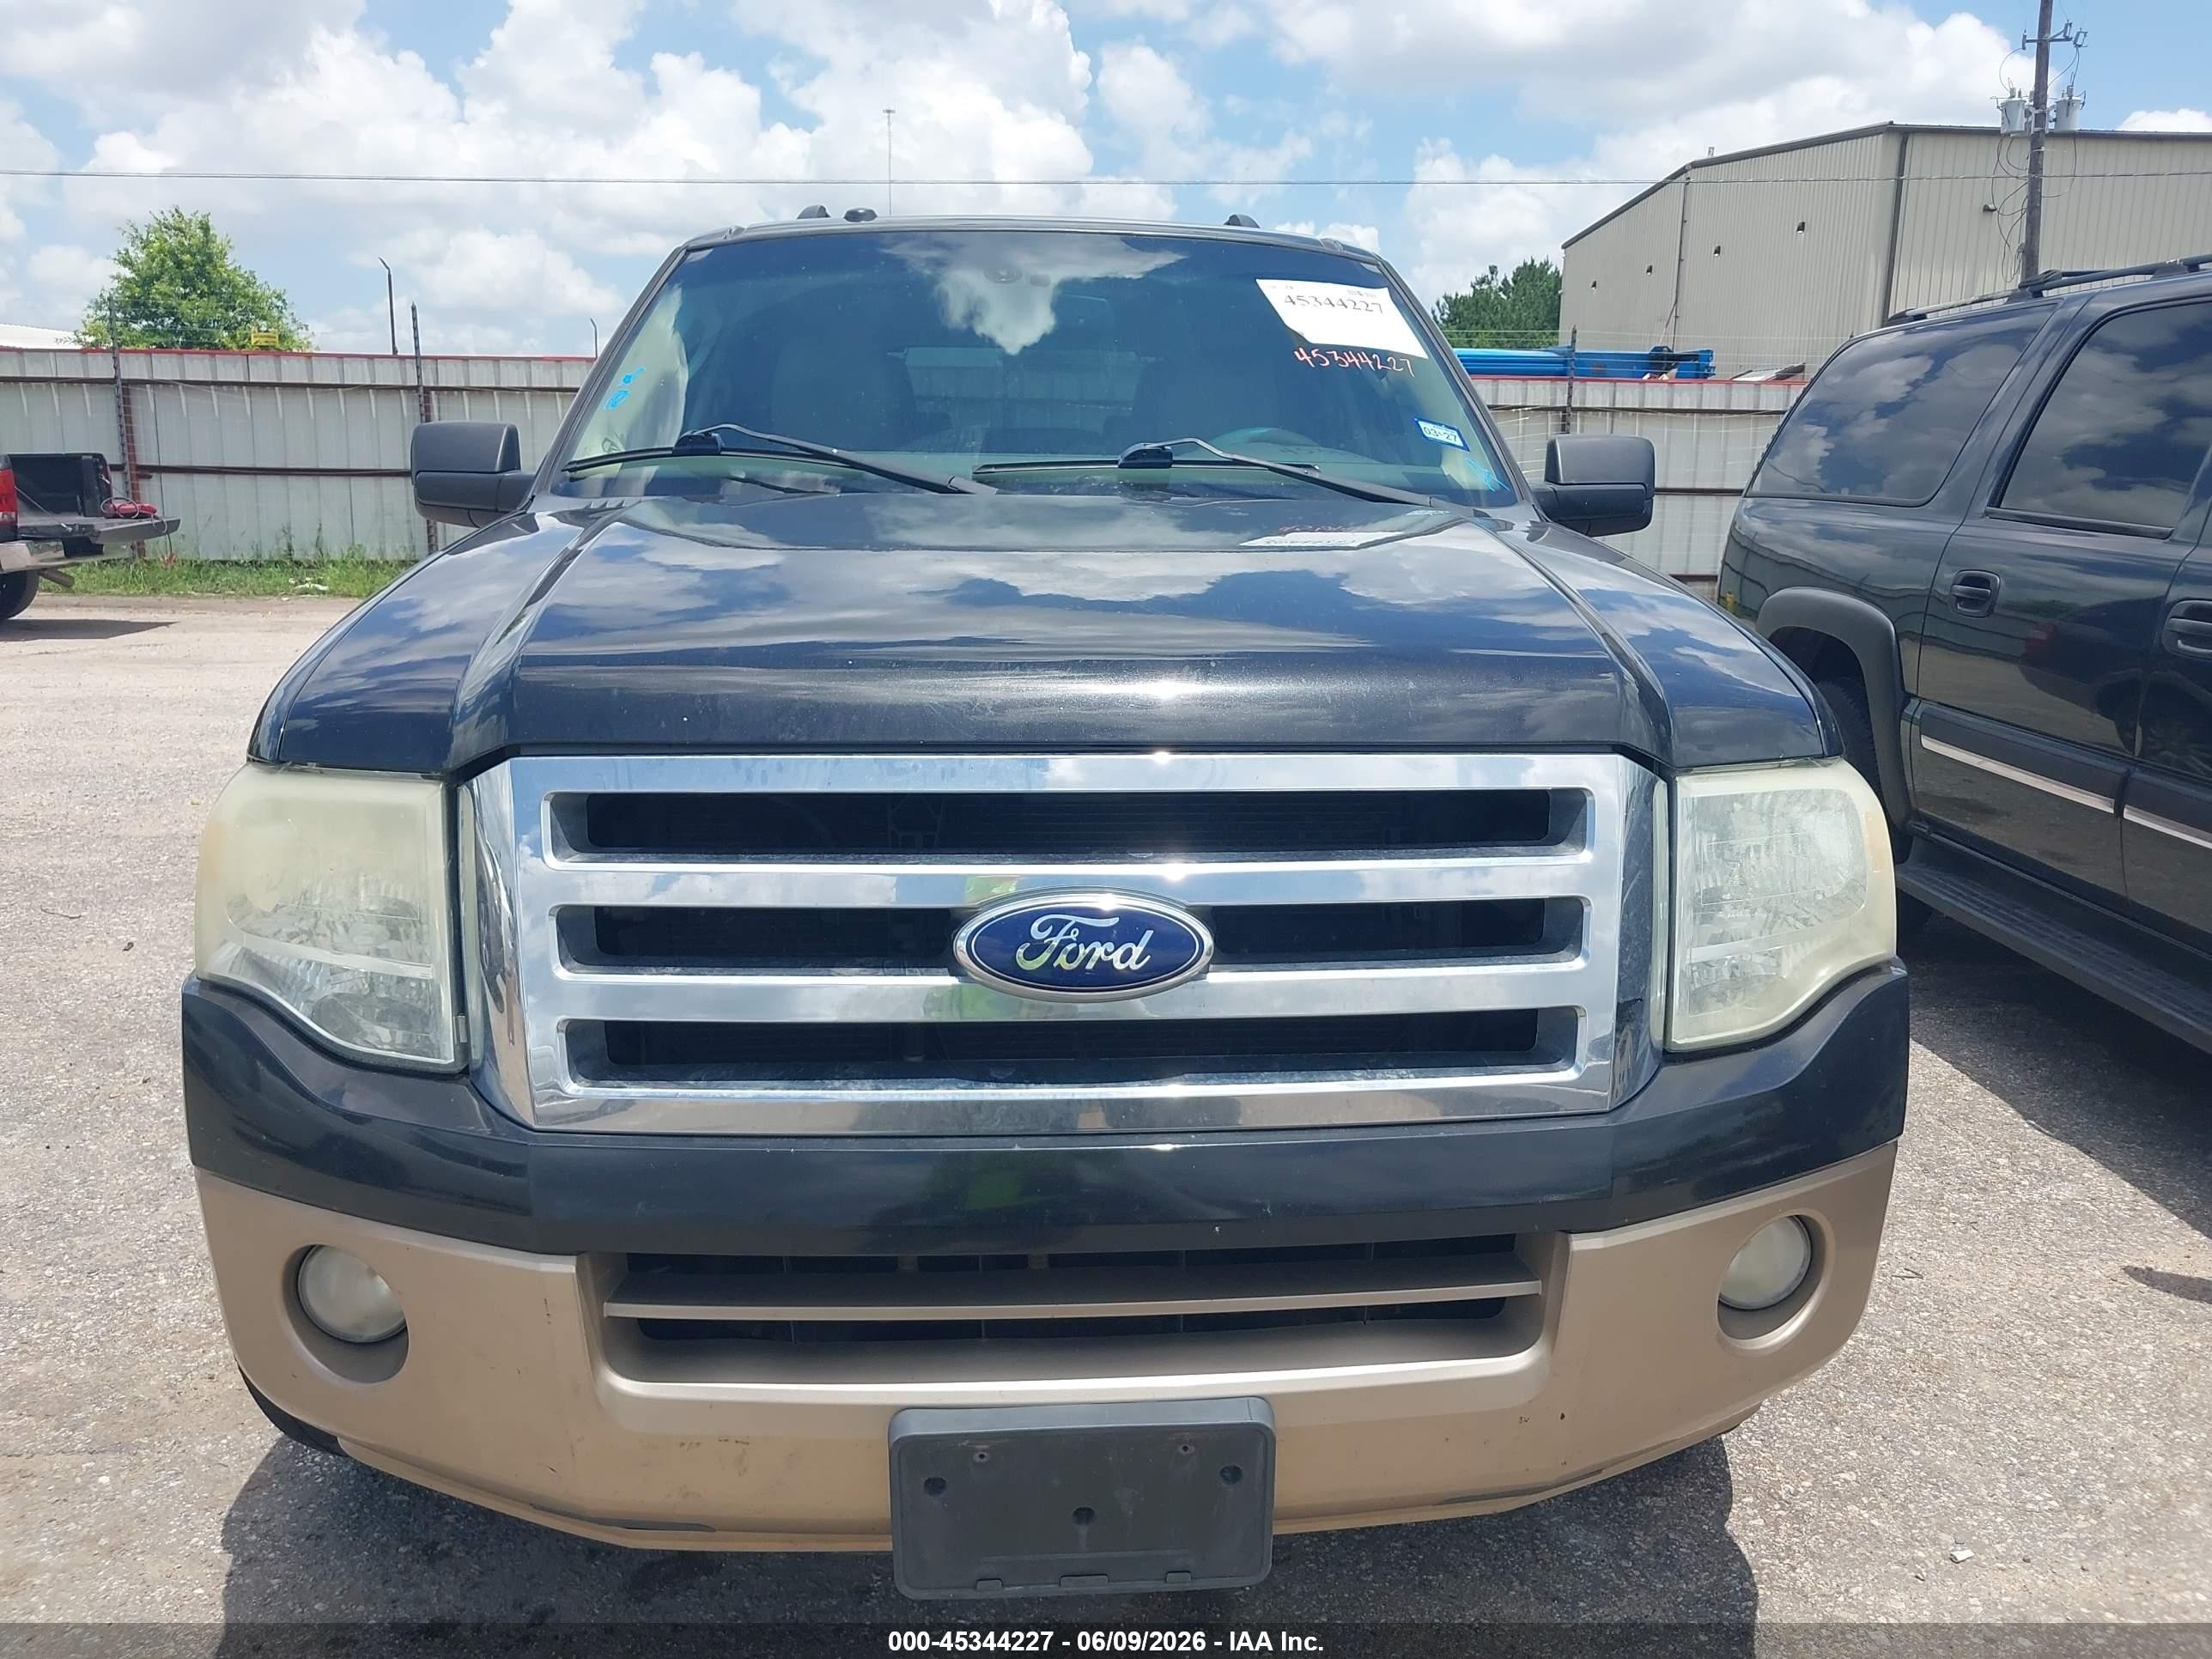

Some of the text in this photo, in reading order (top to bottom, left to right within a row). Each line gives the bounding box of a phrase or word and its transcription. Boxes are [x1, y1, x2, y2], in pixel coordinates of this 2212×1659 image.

[1284, 295, 1383, 314] 45344227
[1293, 347, 1416, 379] 45344227
[1015, 913, 1154, 971] Ford
